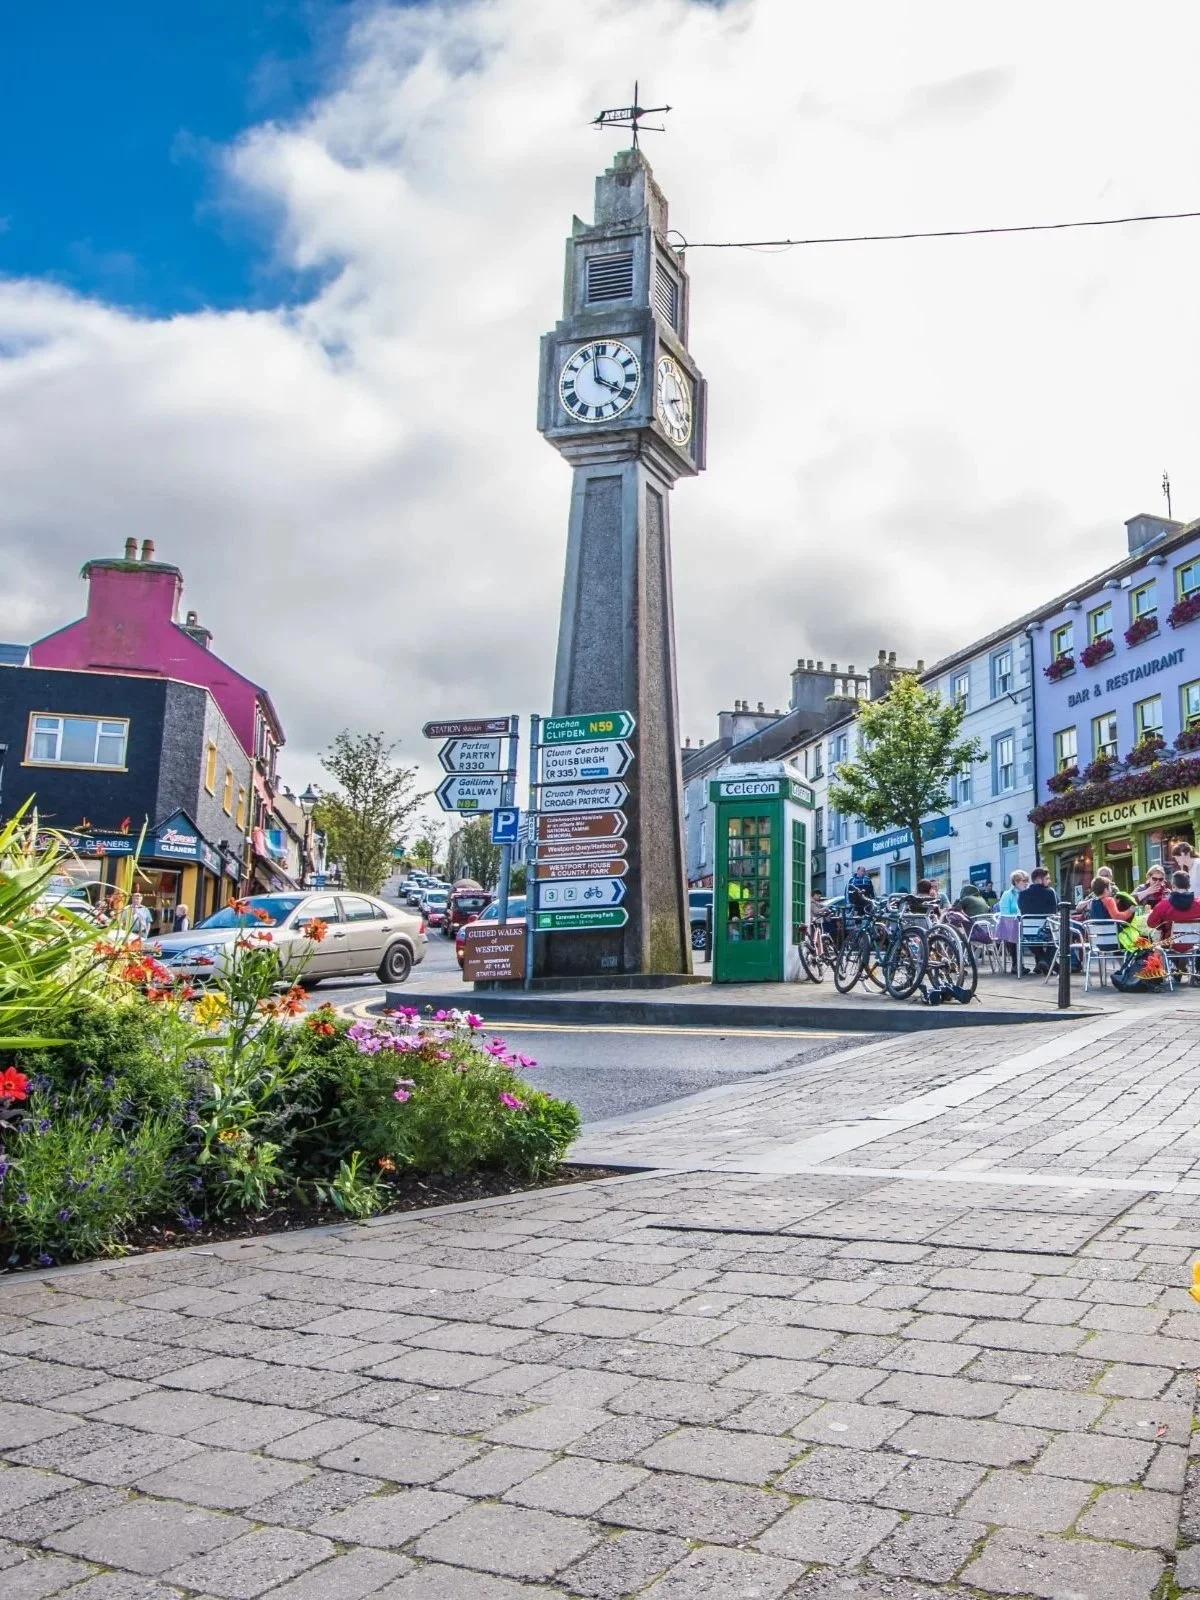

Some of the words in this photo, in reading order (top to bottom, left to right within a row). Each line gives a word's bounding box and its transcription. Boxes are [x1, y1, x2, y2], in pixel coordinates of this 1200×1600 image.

[1068, 688, 1090, 708] BAR
[1094, 684, 1102, 697] &
[1106, 648, 1185, 692] RESTAURANT
[430, 725, 461, 734] STATION
[590, 721, 613, 733] N59
[546, 729, 585, 739] CLIFDEN
[460, 752, 496, 760] PARTRY
[547, 750, 572, 758] Cluain
[546, 756, 605, 767] LOUISBURGH
[459, 778, 494, 786] Gaillimh
[458, 788, 498, 796] GALWAY
[546, 789, 574, 798] Cruach
[457, 800, 477, 808] N84
[545, 799, 577, 808] CROAGH
[579, 796, 610, 805] PATRICK
[1076, 815, 1095, 830] THE
[1100, 804, 1137, 824] CLOCK
[1142, 791, 1190, 814] TAVERN
[497, 812, 515, 833] P
[86, 840, 130, 848] CLEANERS
[576, 842, 617, 852] Quay/Harbour
[873, 840, 884, 852] Bank
[885, 838, 890, 848] of
[161, 846, 197, 855] CLEANERS
[549, 863, 586, 871] WESTPORT
[548, 892, 555, 900] 3
[568, 890, 574, 898] 2
[469, 930, 497, 938] GUIDED
[498, 928, 523, 936] WALKS
[475, 945, 515, 953] WESTPORT
